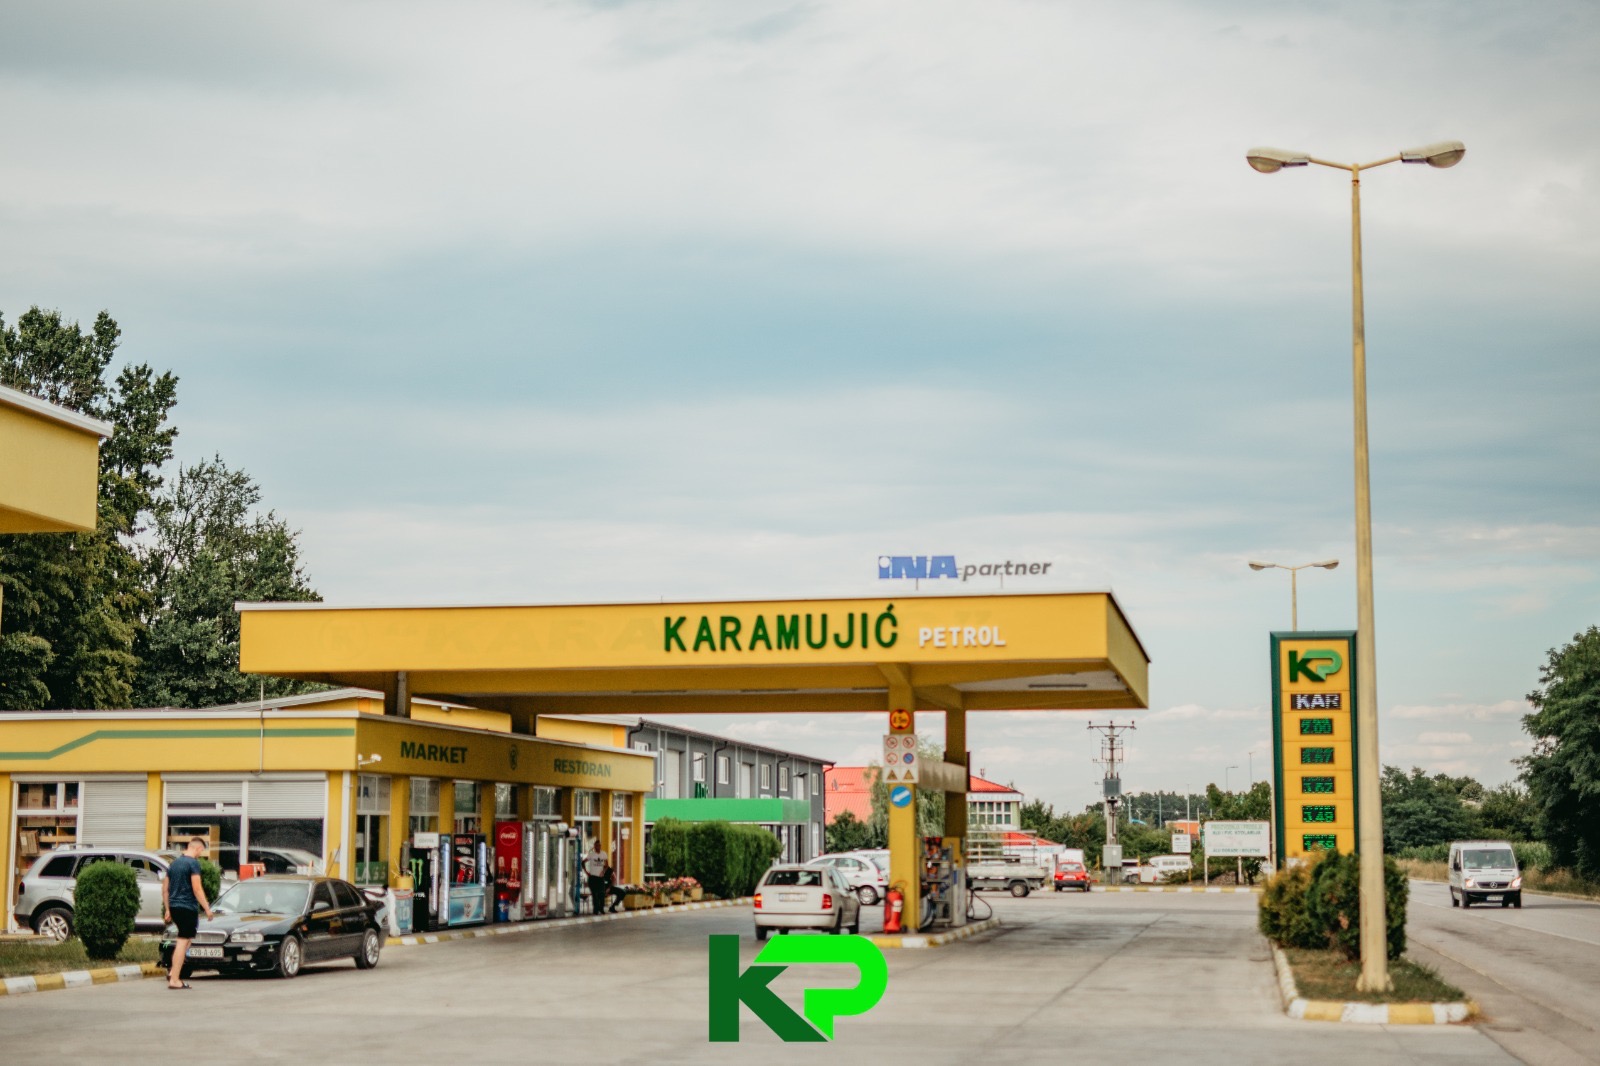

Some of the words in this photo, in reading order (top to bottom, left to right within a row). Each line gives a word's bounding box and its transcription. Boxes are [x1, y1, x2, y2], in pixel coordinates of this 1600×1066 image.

[962, 560, 1053, 582] partner
[663, 603, 899, 652] KARAMUJIĆ
[918, 625, 1007, 648] PETROL
[400, 740, 468, 764] MARKET
[553, 757, 612, 778] RESTORAN
